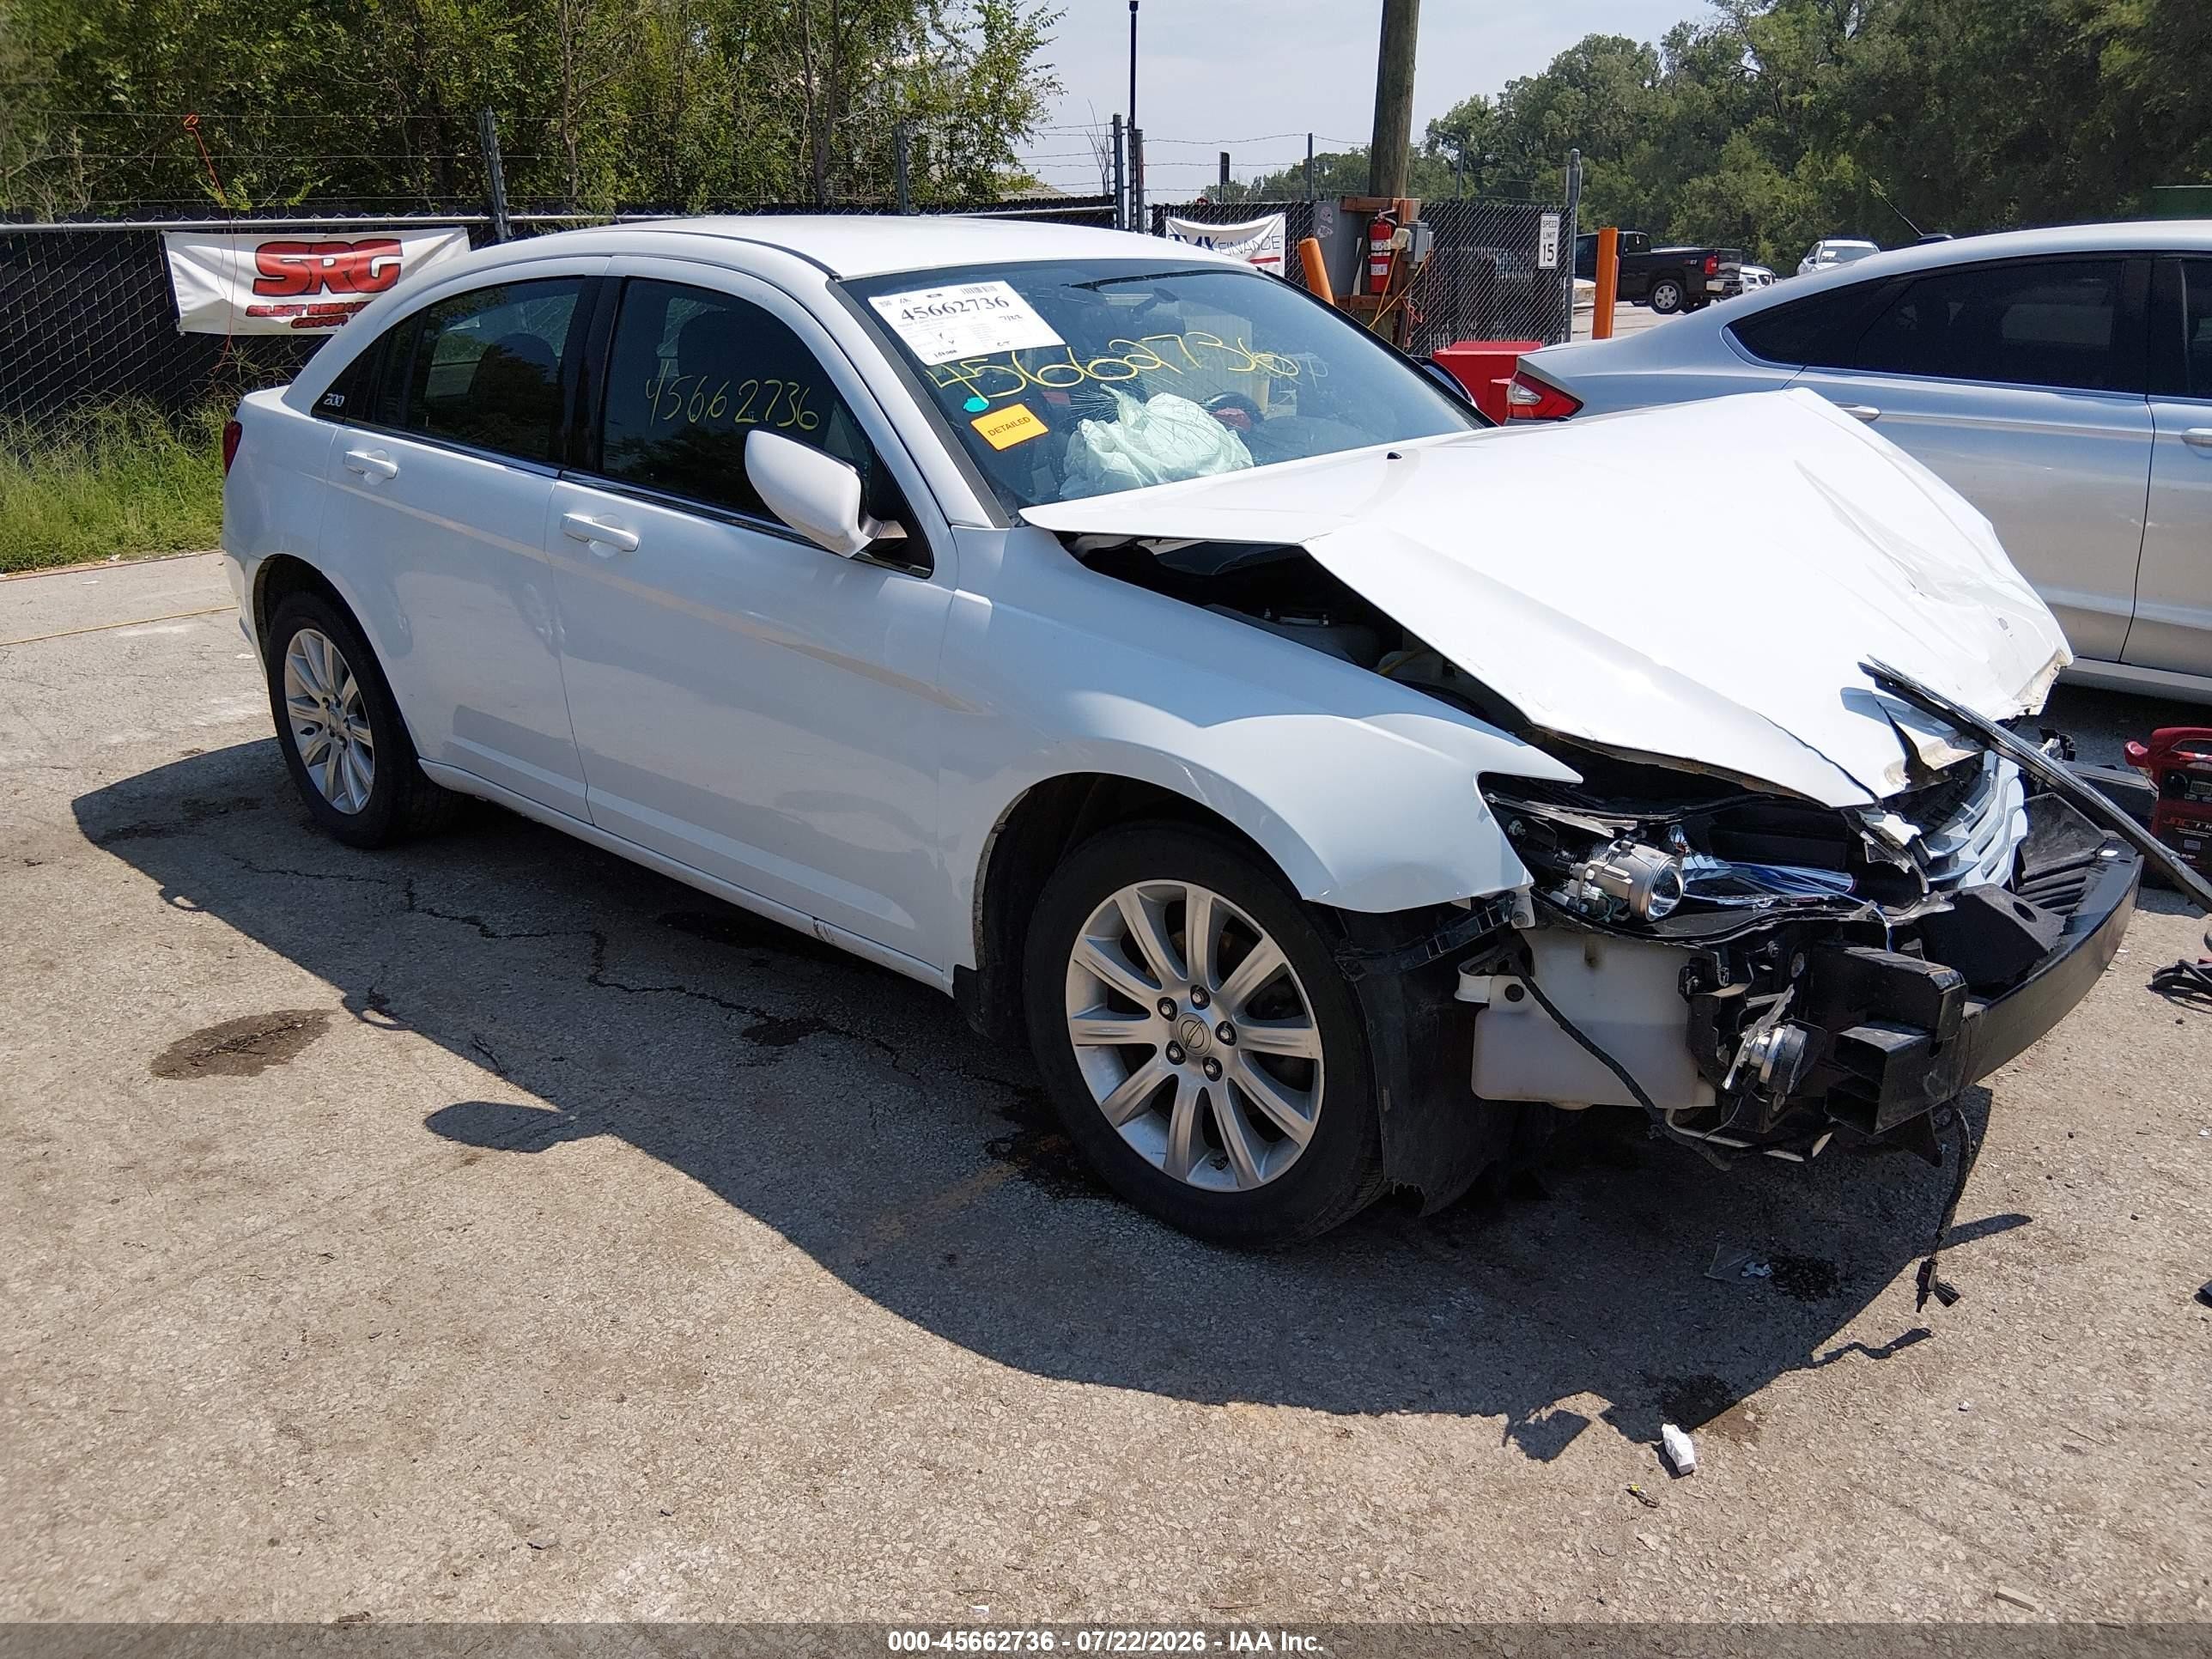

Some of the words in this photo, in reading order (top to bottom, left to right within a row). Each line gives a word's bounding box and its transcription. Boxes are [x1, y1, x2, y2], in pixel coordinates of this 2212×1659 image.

[1218, 234, 1281, 255] FINANCE
[1543, 243, 1554, 262] 15
[252, 238, 404, 296] SRG
[246, 304, 307, 317] SELECT
[902, 296, 1009, 320] 45662736
[925, 331, 1299, 406] 45662736
[323, 392, 345, 407] 200
[646, 361, 819, 429] 45662736
[988, 416, 1031, 436] DETAILED
